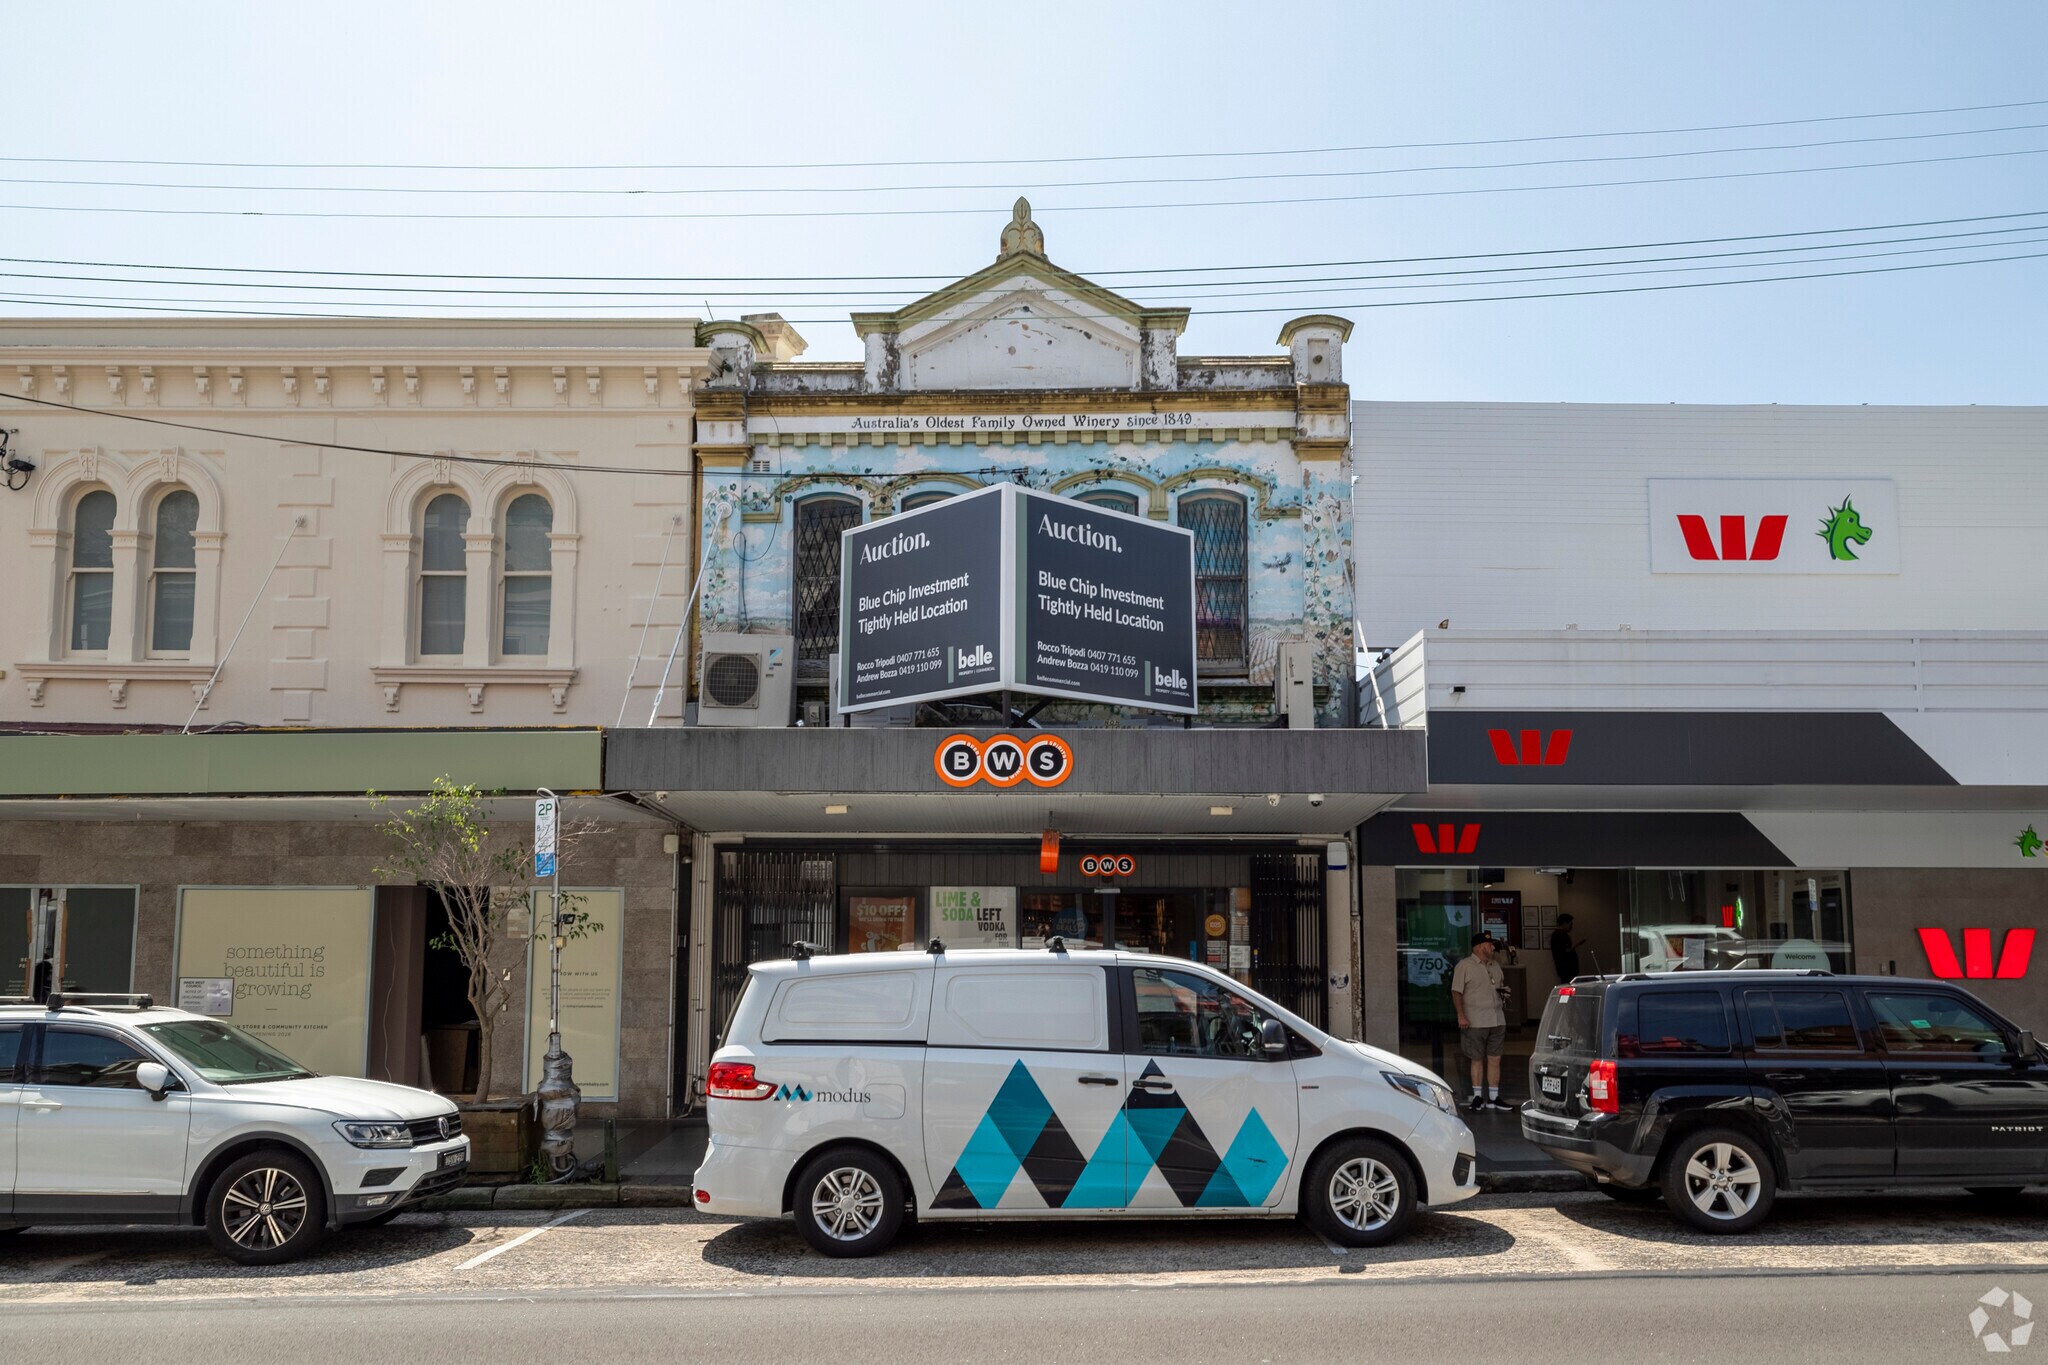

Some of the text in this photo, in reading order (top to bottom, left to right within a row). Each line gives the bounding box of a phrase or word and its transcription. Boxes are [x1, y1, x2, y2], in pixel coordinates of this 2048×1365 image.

[851, 416, 919, 429] Australia's
[926, 416, 965, 429] Oldest
[972, 416, 1016, 430] Family
[1022, 415, 1066, 429] Owned
[1073, 415, 1120, 429] Winery
[1164, 412, 1192, 426] 1849
[1038, 513, 1122, 553] Auction.
[860, 532, 930, 565] Auction.
[859, 572, 969, 612] Blue Chip Investment
[1039, 570, 1164, 610] Blue Chip Investment
[858, 598, 968, 635] Tightly Held Location
[1038, 594, 1164, 632] Tightly Held Location
[856, 646, 940, 671] Rocco Tripodi 0407 771 655
[958, 645, 993, 669] belle
[1037, 640, 1136, 666] Rocco Tripodi 0407 771 655
[856, 659, 942, 684] Andrew Bozza 0419 110 099
[1037, 654, 1139, 679] Andrew Bozza 0419 110 099
[1155, 666, 1188, 690] belle
[538, 803, 553, 816] 2P
[856, 904, 908, 917] $10 OFF?
[935, 892, 981, 908] LIME &
[942, 908, 1001, 921] SODA LEFT
[978, 922, 1005, 932] VODKA
[226, 944, 325, 962] something
[1413, 957, 1443, 971] $750
[224, 962, 325, 978] beautiful is
[235, 982, 312, 999] growing
[816, 1088, 871, 1104] modus
